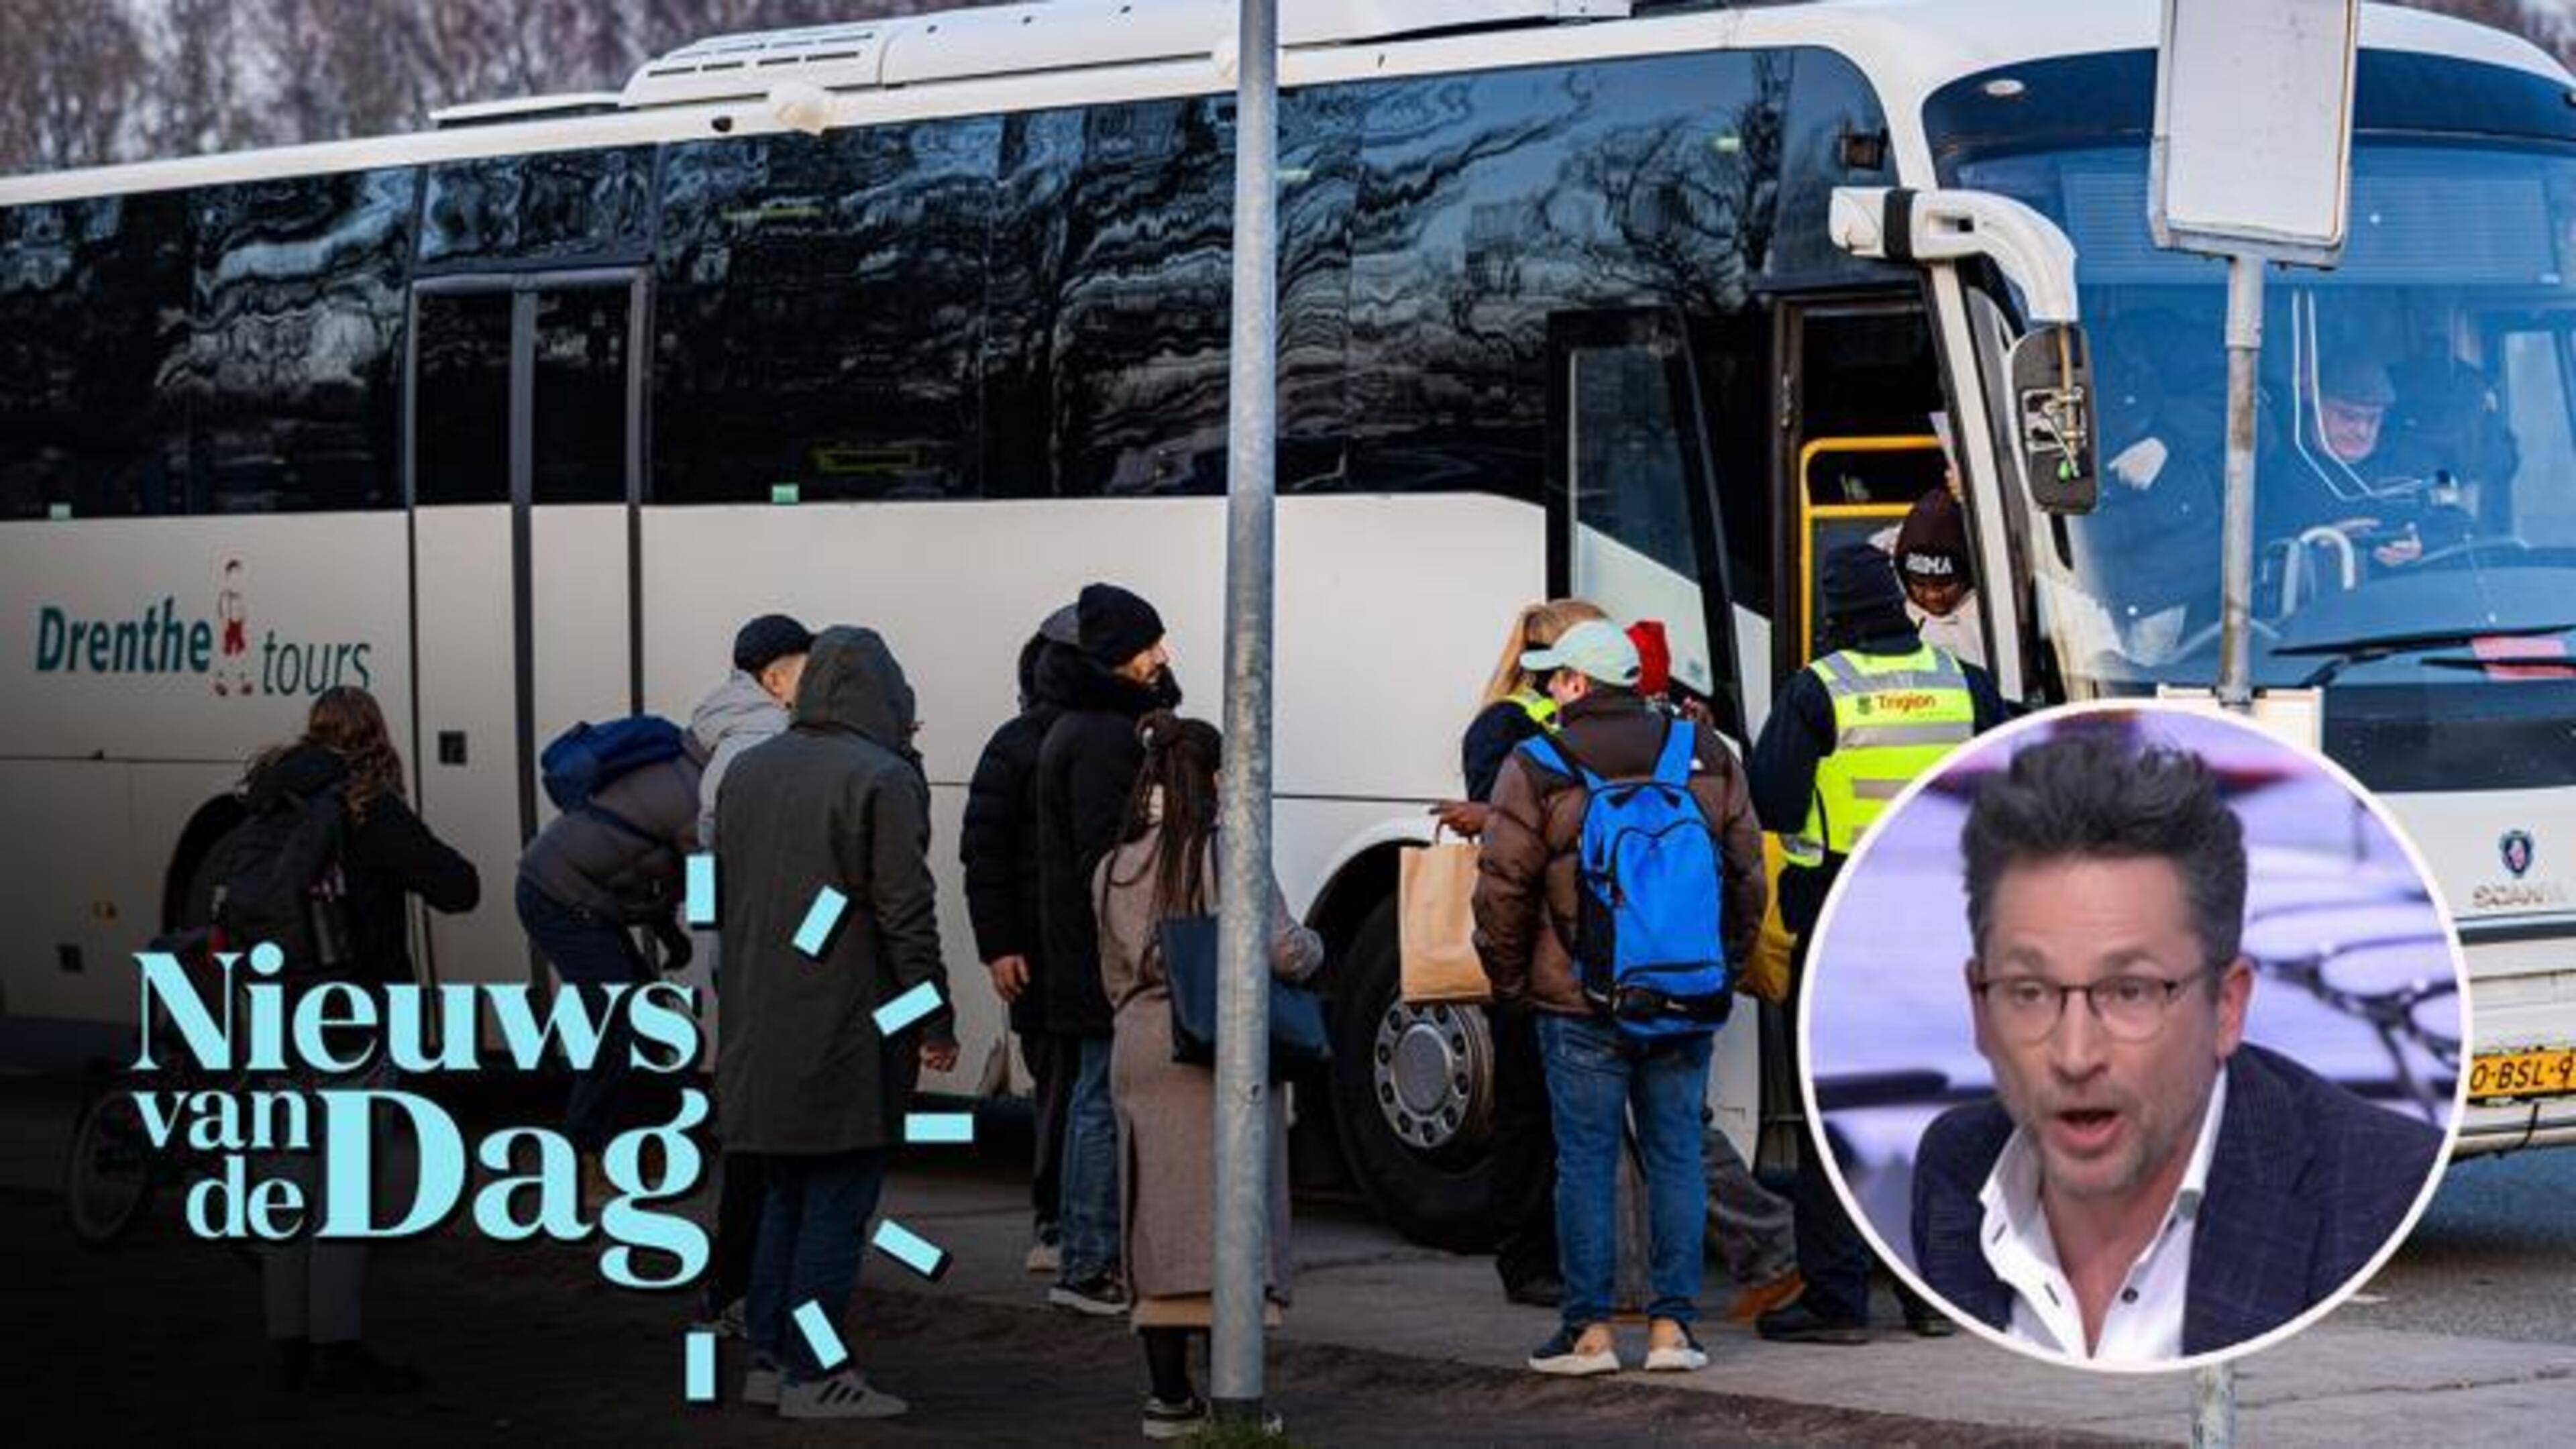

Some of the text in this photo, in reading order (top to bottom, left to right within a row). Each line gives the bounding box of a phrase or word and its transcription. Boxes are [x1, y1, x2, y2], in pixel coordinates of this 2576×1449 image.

[37, 596, 372, 695] Drenthe tours
[1876, 692, 1935, 712] Trigion
